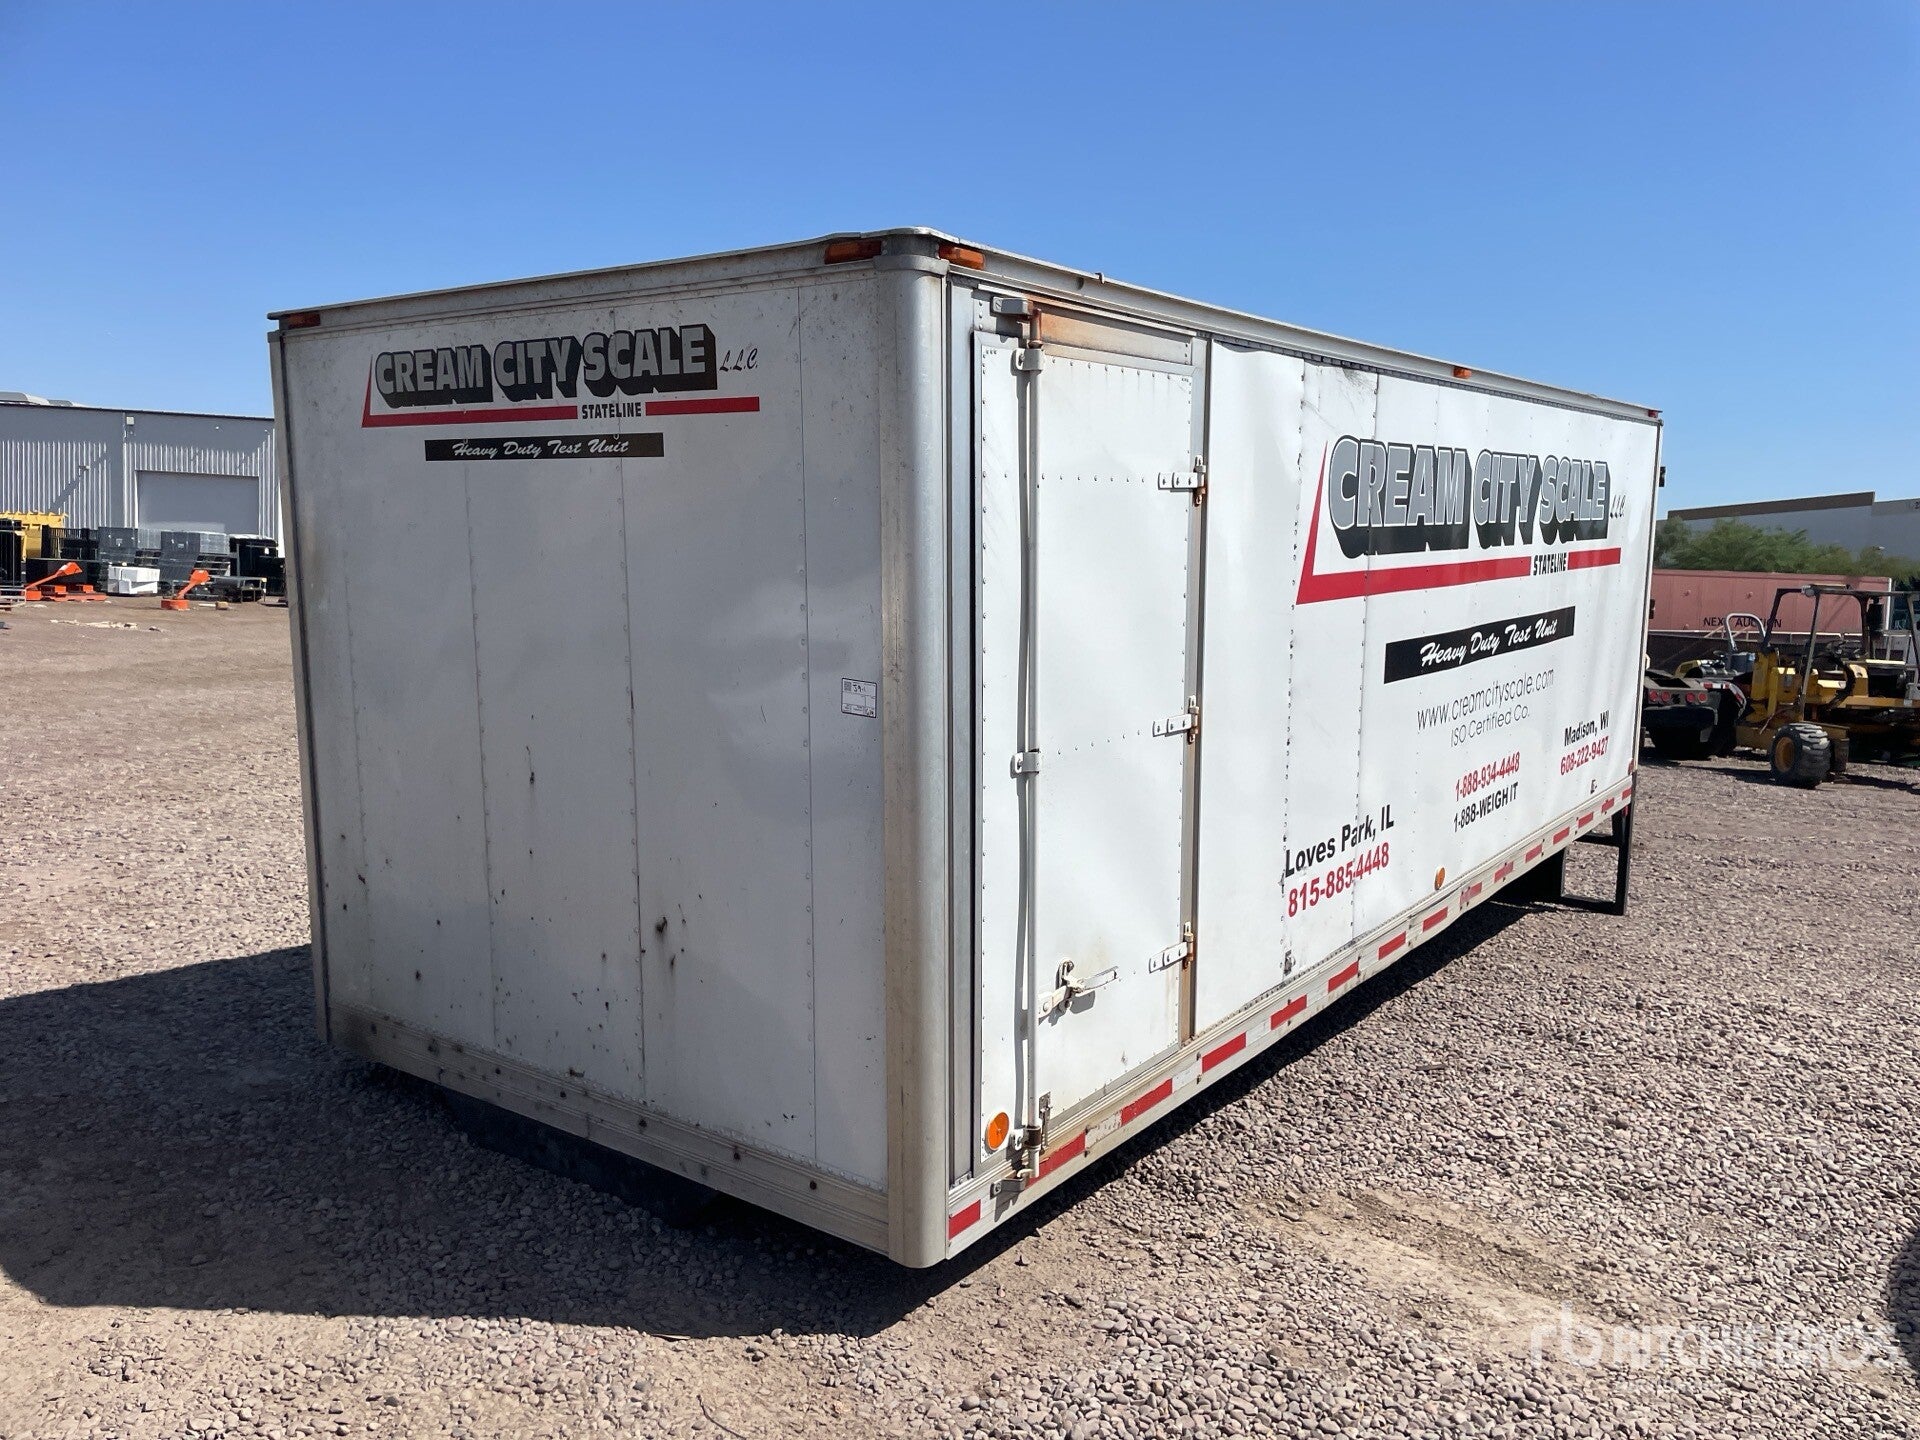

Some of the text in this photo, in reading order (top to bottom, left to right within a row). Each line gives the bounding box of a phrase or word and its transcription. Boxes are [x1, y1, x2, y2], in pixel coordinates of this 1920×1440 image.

[375, 343, 493, 409] CREAM
[493, 336, 584, 403] CITY
[581, 323, 718, 398] SCALE
[582, 402, 642, 420] STATELINE
[452, 438, 630, 460] Heavy Duty Test Unit
[1328, 434, 1472, 559] CREAM
[1472, 449, 1542, 550] CITY
[1539, 455, 1611, 545] SCALE
[1532, 552, 1567, 577] STATELINE
[1420, 618, 1558, 667] Heavy Duty Test Unit
[1417, 669, 1555, 730] www.creamcityscale.com
[1450, 704, 1530, 748] ISO Certified Co.
[1564, 710, 1610, 746] Madison, WI
[1455, 751, 1521, 802] 1-888-934-4448
[1560, 735, 1610, 776] 608-222-9427
[1285, 804, 1395, 878] Loves Park, IL
[1288, 842, 1390, 918] 815-885-4448
